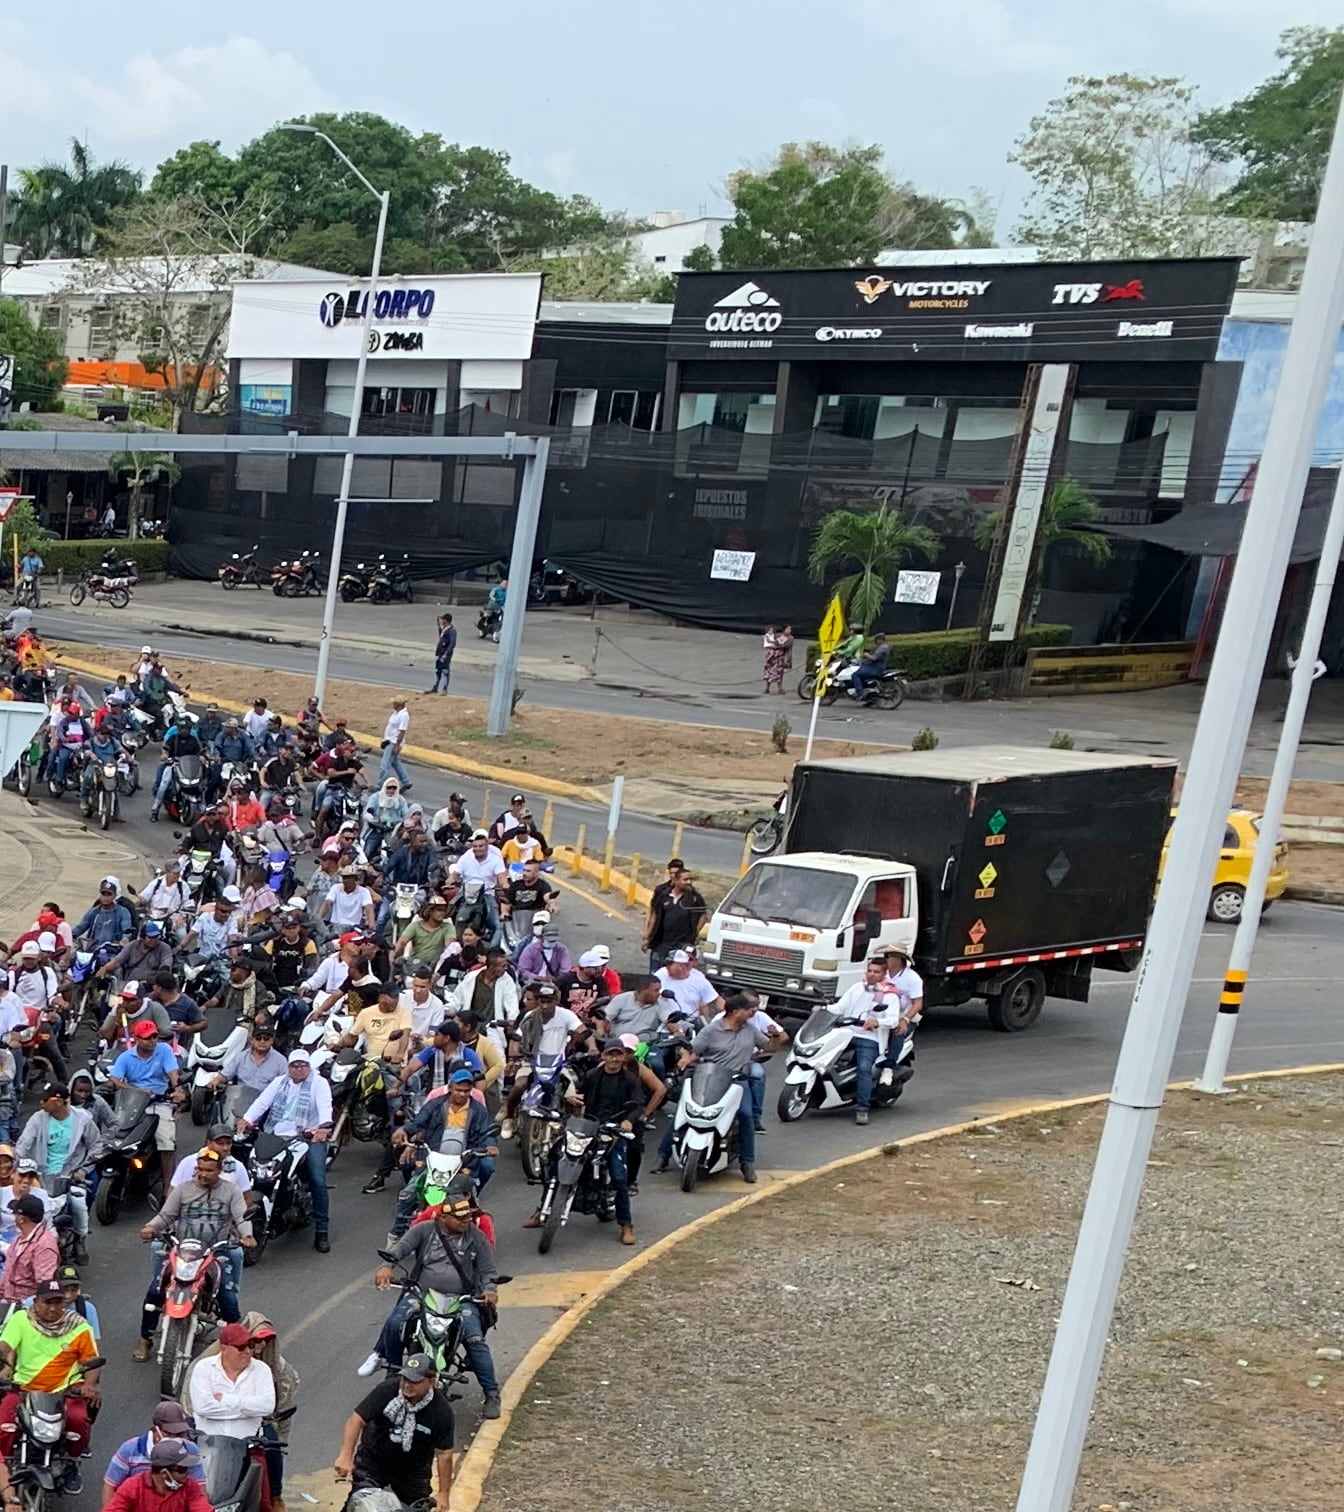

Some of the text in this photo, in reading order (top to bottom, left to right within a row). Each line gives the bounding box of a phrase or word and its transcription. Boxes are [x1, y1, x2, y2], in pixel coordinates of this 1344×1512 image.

[893, 281, 992, 296] VICTORY
[1052, 283, 1103, 304] TVS
[908, 300, 969, 309] MOTORCYCLES
[705, 308, 782, 332] auteco
[834, 328, 883, 340] KYMCO
[964, 323, 1034, 338] Kawasaki
[1117, 321, 1174, 337] Benelli
